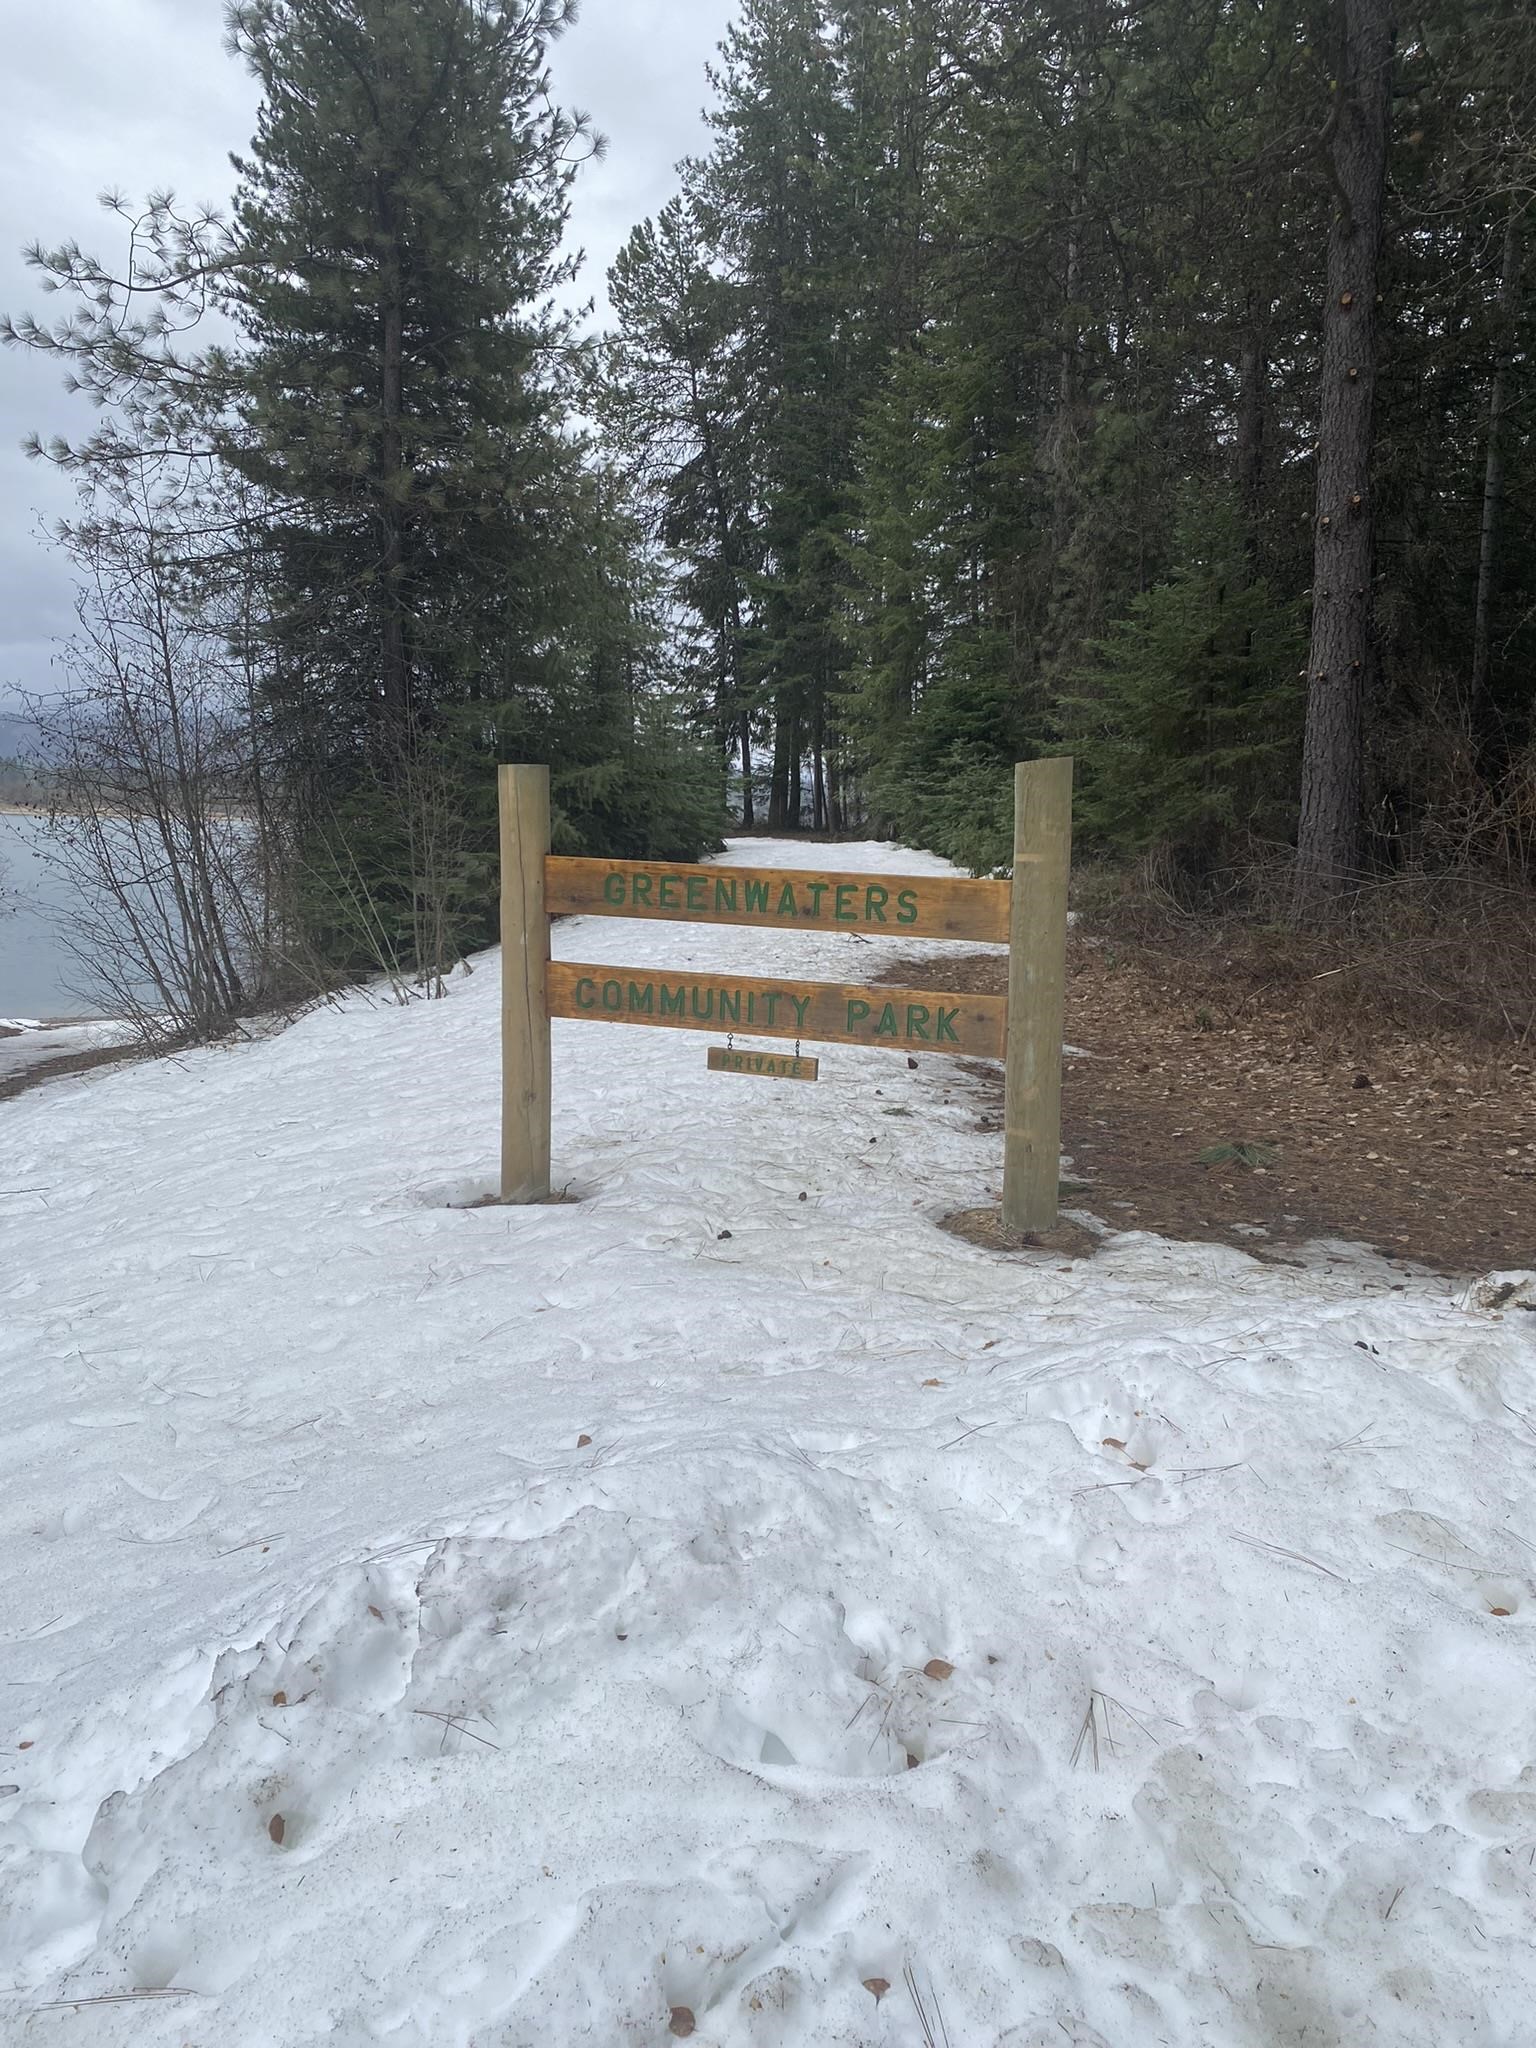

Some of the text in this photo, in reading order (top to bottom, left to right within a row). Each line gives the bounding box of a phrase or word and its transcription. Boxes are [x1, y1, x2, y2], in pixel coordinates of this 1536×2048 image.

[604, 873, 919, 923] GREENWATERS
[575, 978, 961, 1041] COMMUNITY PARK
[721, 1053, 802, 1076] PRIVATE
